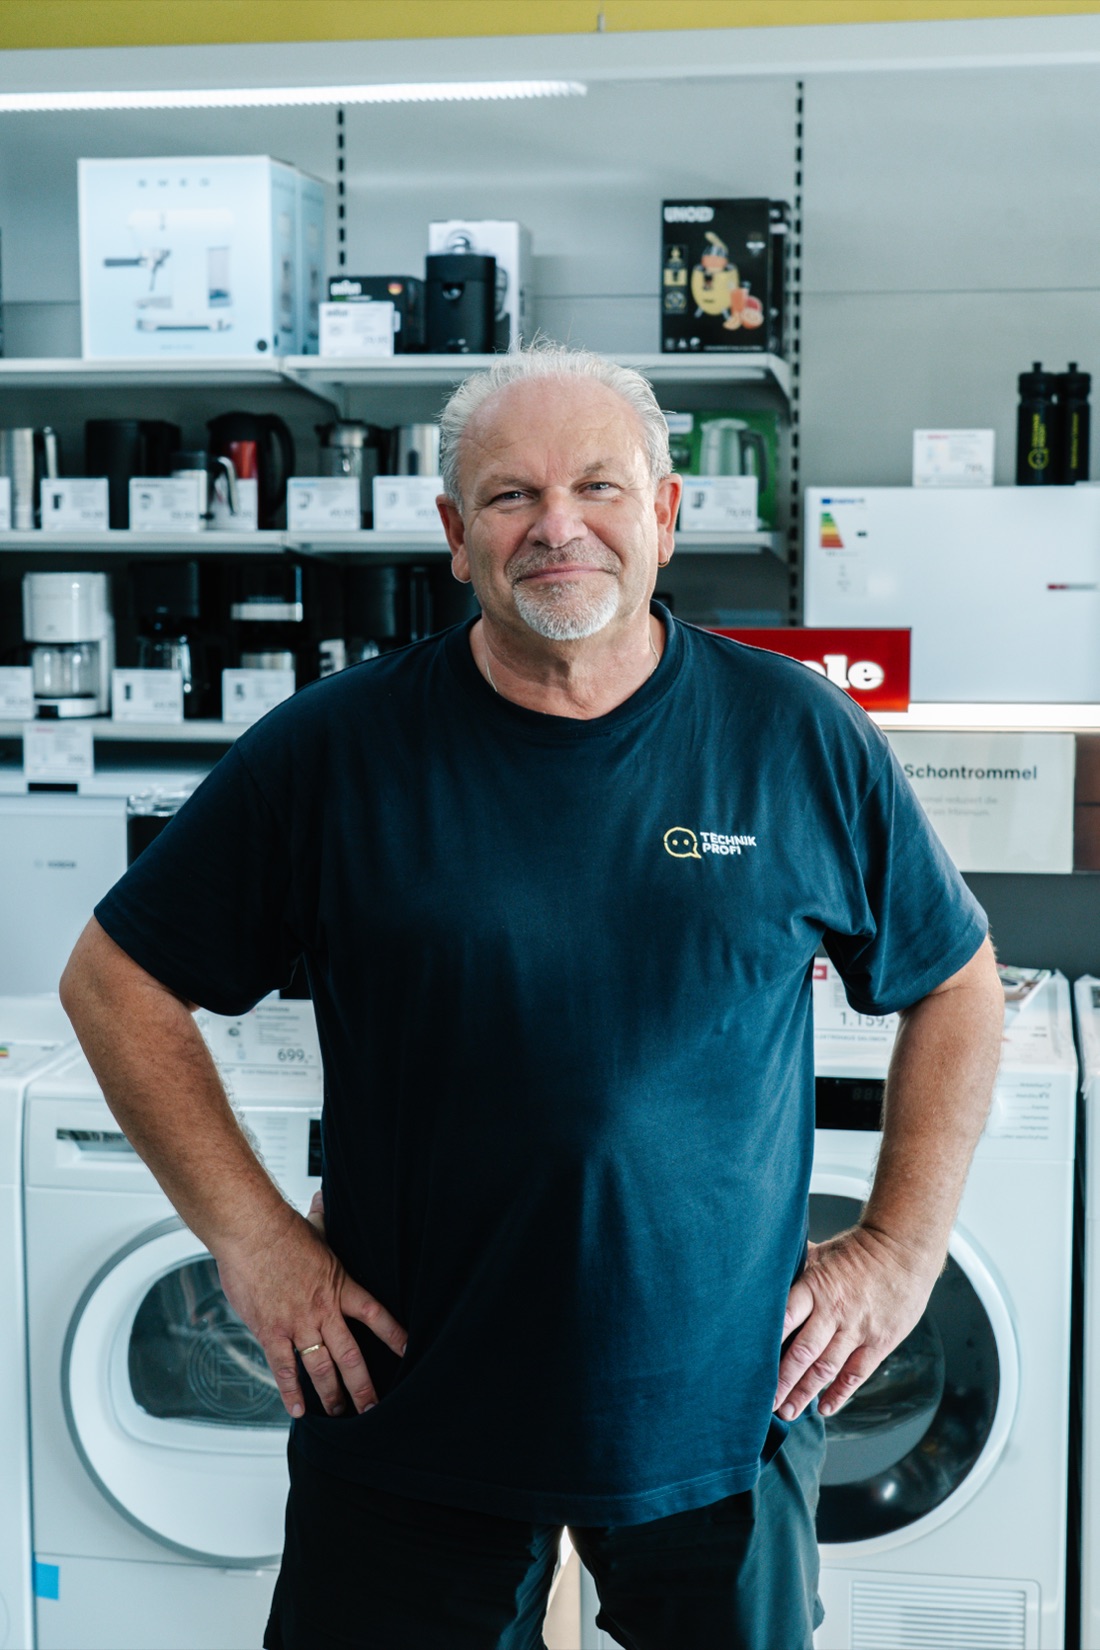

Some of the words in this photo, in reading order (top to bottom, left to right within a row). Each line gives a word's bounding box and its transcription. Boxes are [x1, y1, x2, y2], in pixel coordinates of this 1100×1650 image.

[904, 764, 1037, 780] Schontrommel
[700, 832, 757, 847] TECHNIK
[702, 843, 741, 855] PROFI
